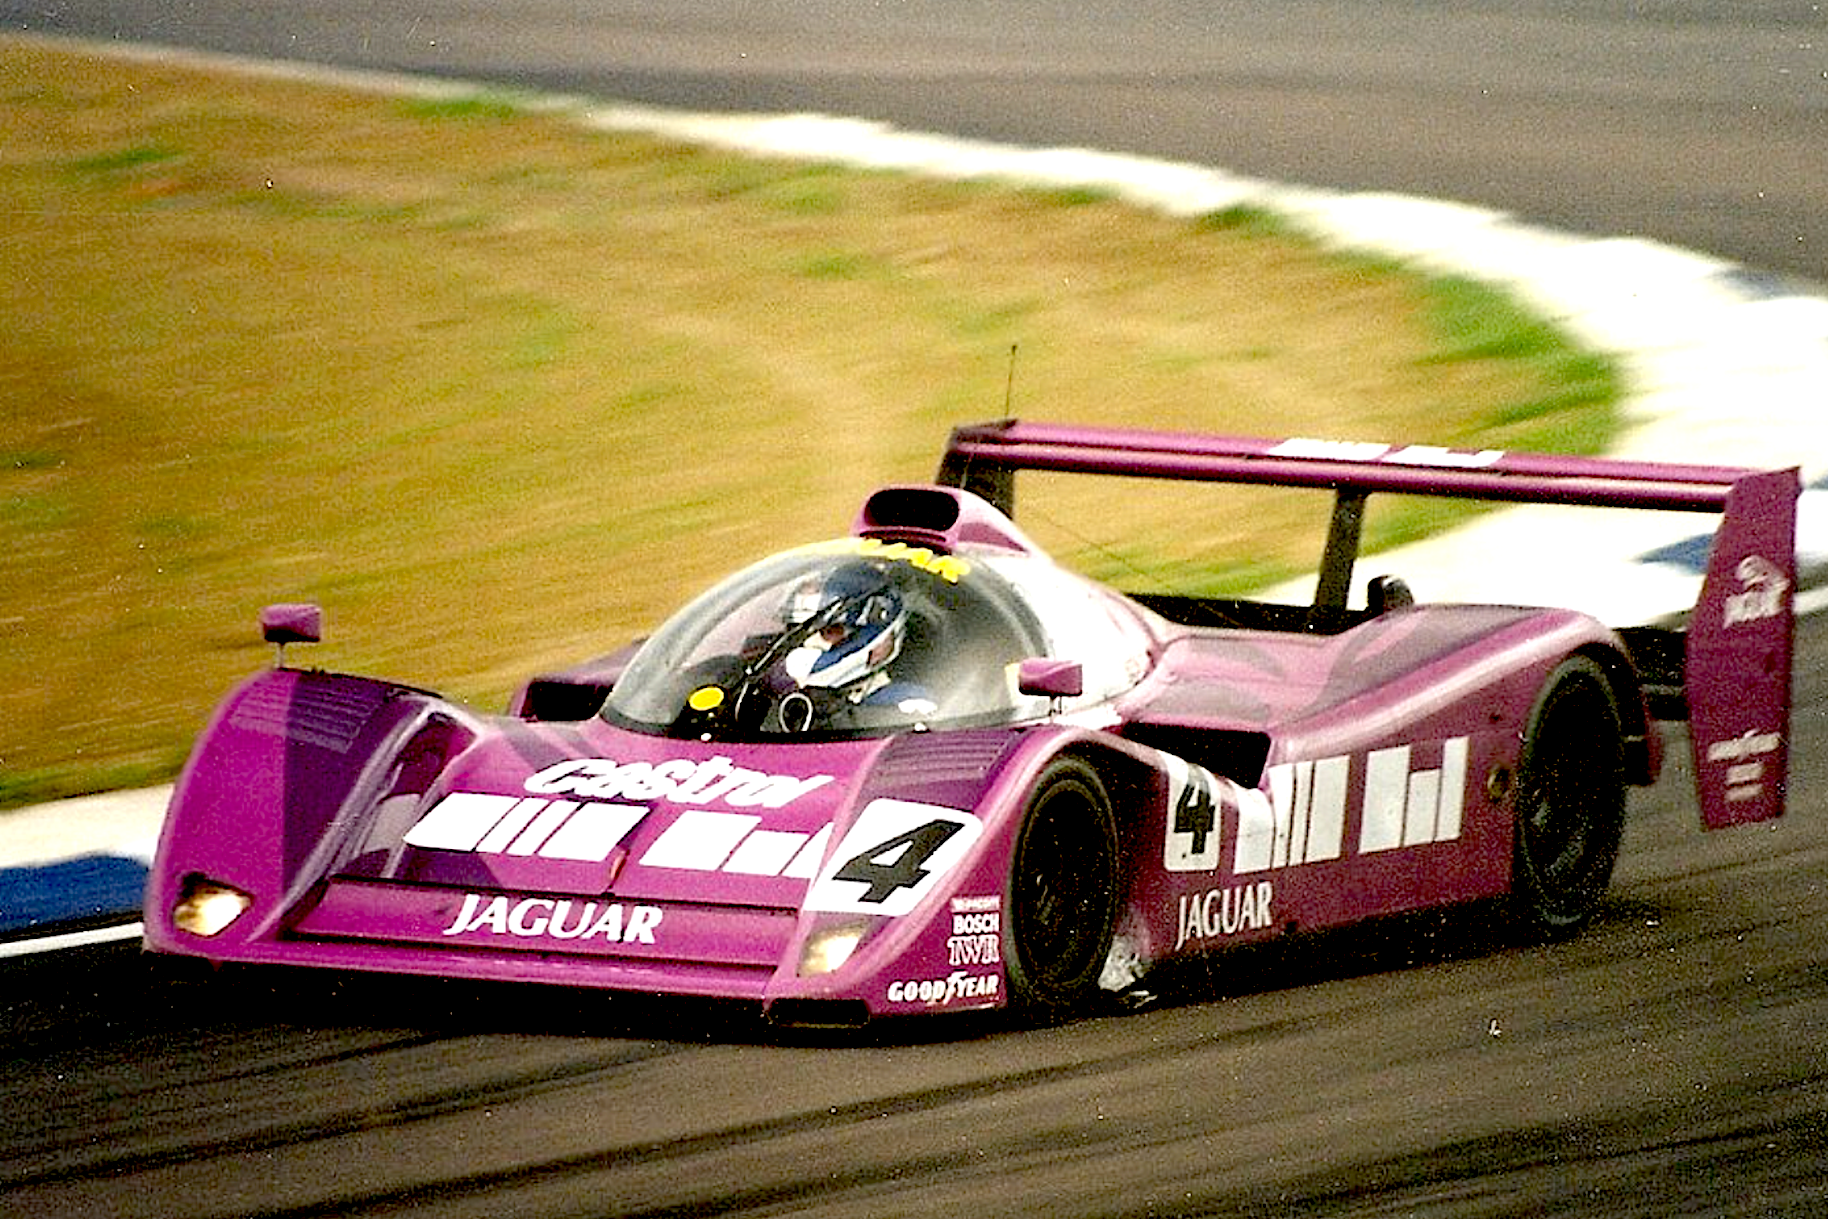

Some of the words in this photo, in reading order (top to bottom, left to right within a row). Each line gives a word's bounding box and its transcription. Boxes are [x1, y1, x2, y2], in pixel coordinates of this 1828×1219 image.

[524, 755, 834, 808] Castrol
[1174, 764, 1216, 855] 4
[832, 818, 966, 904] 4
[443, 893, 664, 945] JAGUAR
[952, 912, 1000, 935] BOSCH
[1175, 880, 1273, 951] JAGUAR
[947, 934, 1000, 966] TWR
[887, 970, 999, 1005] GOODYEAR
